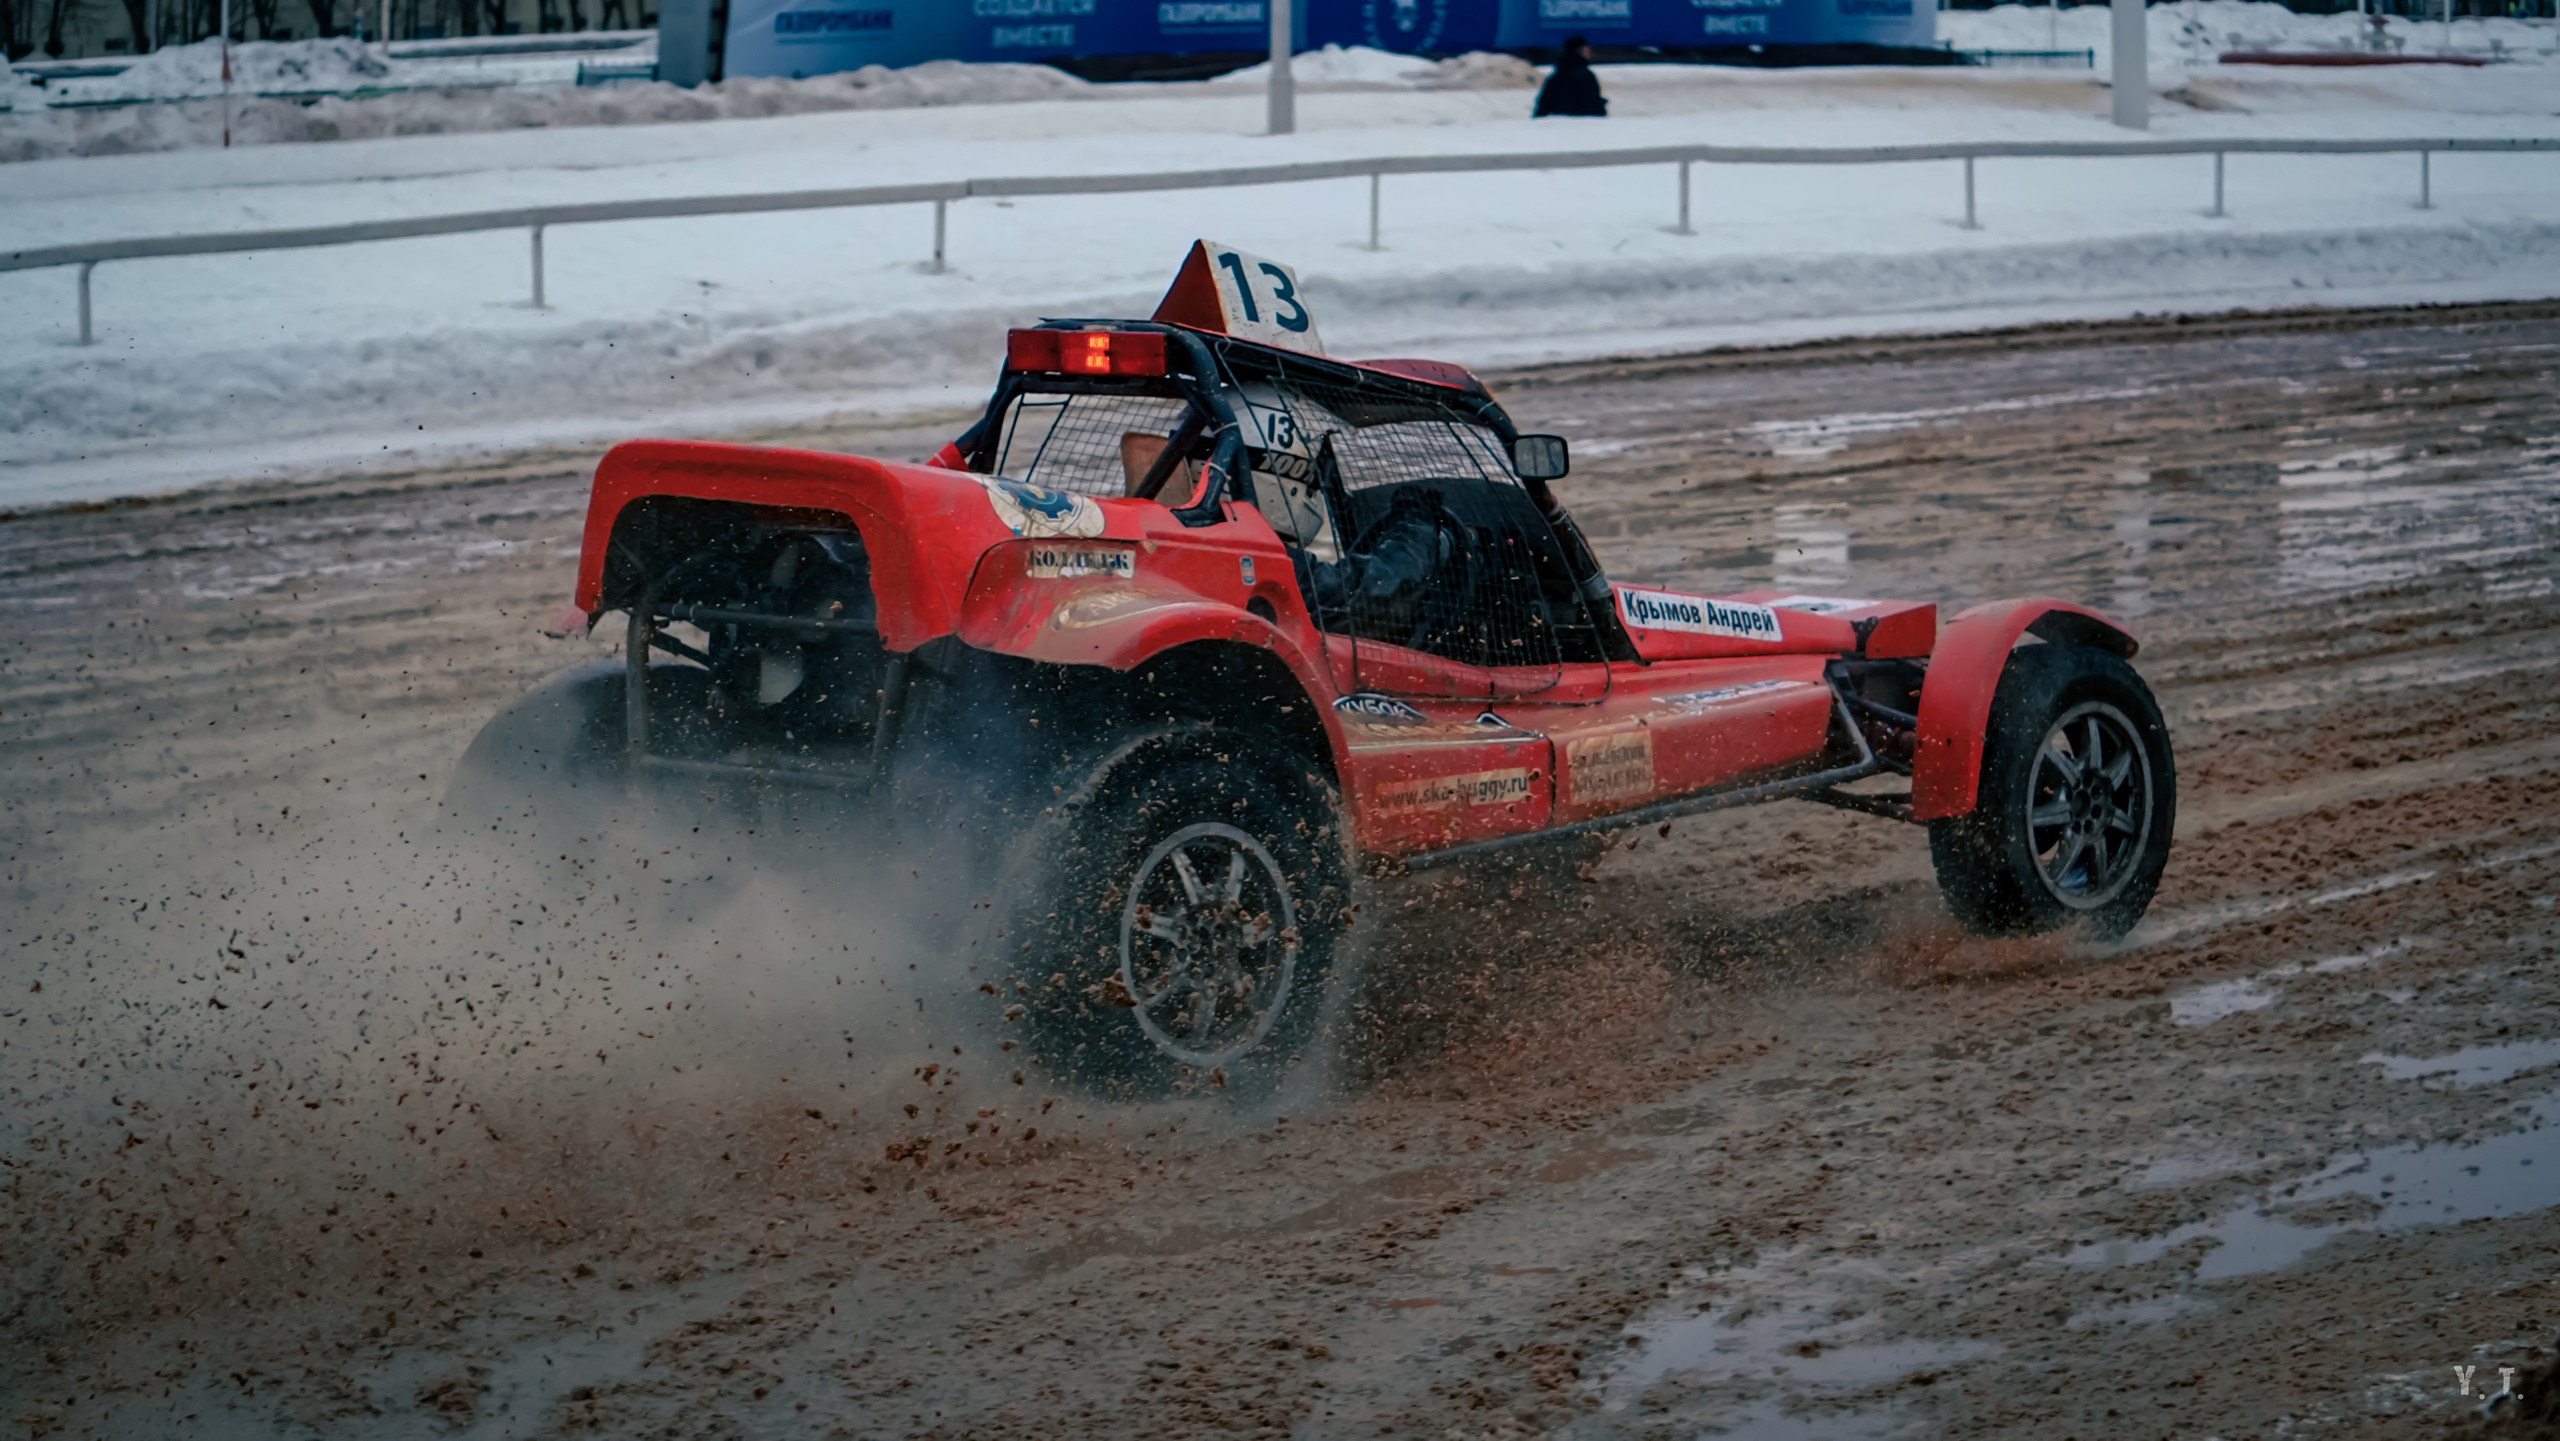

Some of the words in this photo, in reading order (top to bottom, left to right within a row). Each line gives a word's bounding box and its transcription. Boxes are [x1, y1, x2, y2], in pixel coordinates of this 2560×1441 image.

[1217, 252, 1309, 333] 13
[1268, 413, 1294, 449] 13
[1623, 591, 1701, 624] Крымов
[1706, 601, 1775, 635] Андрей
